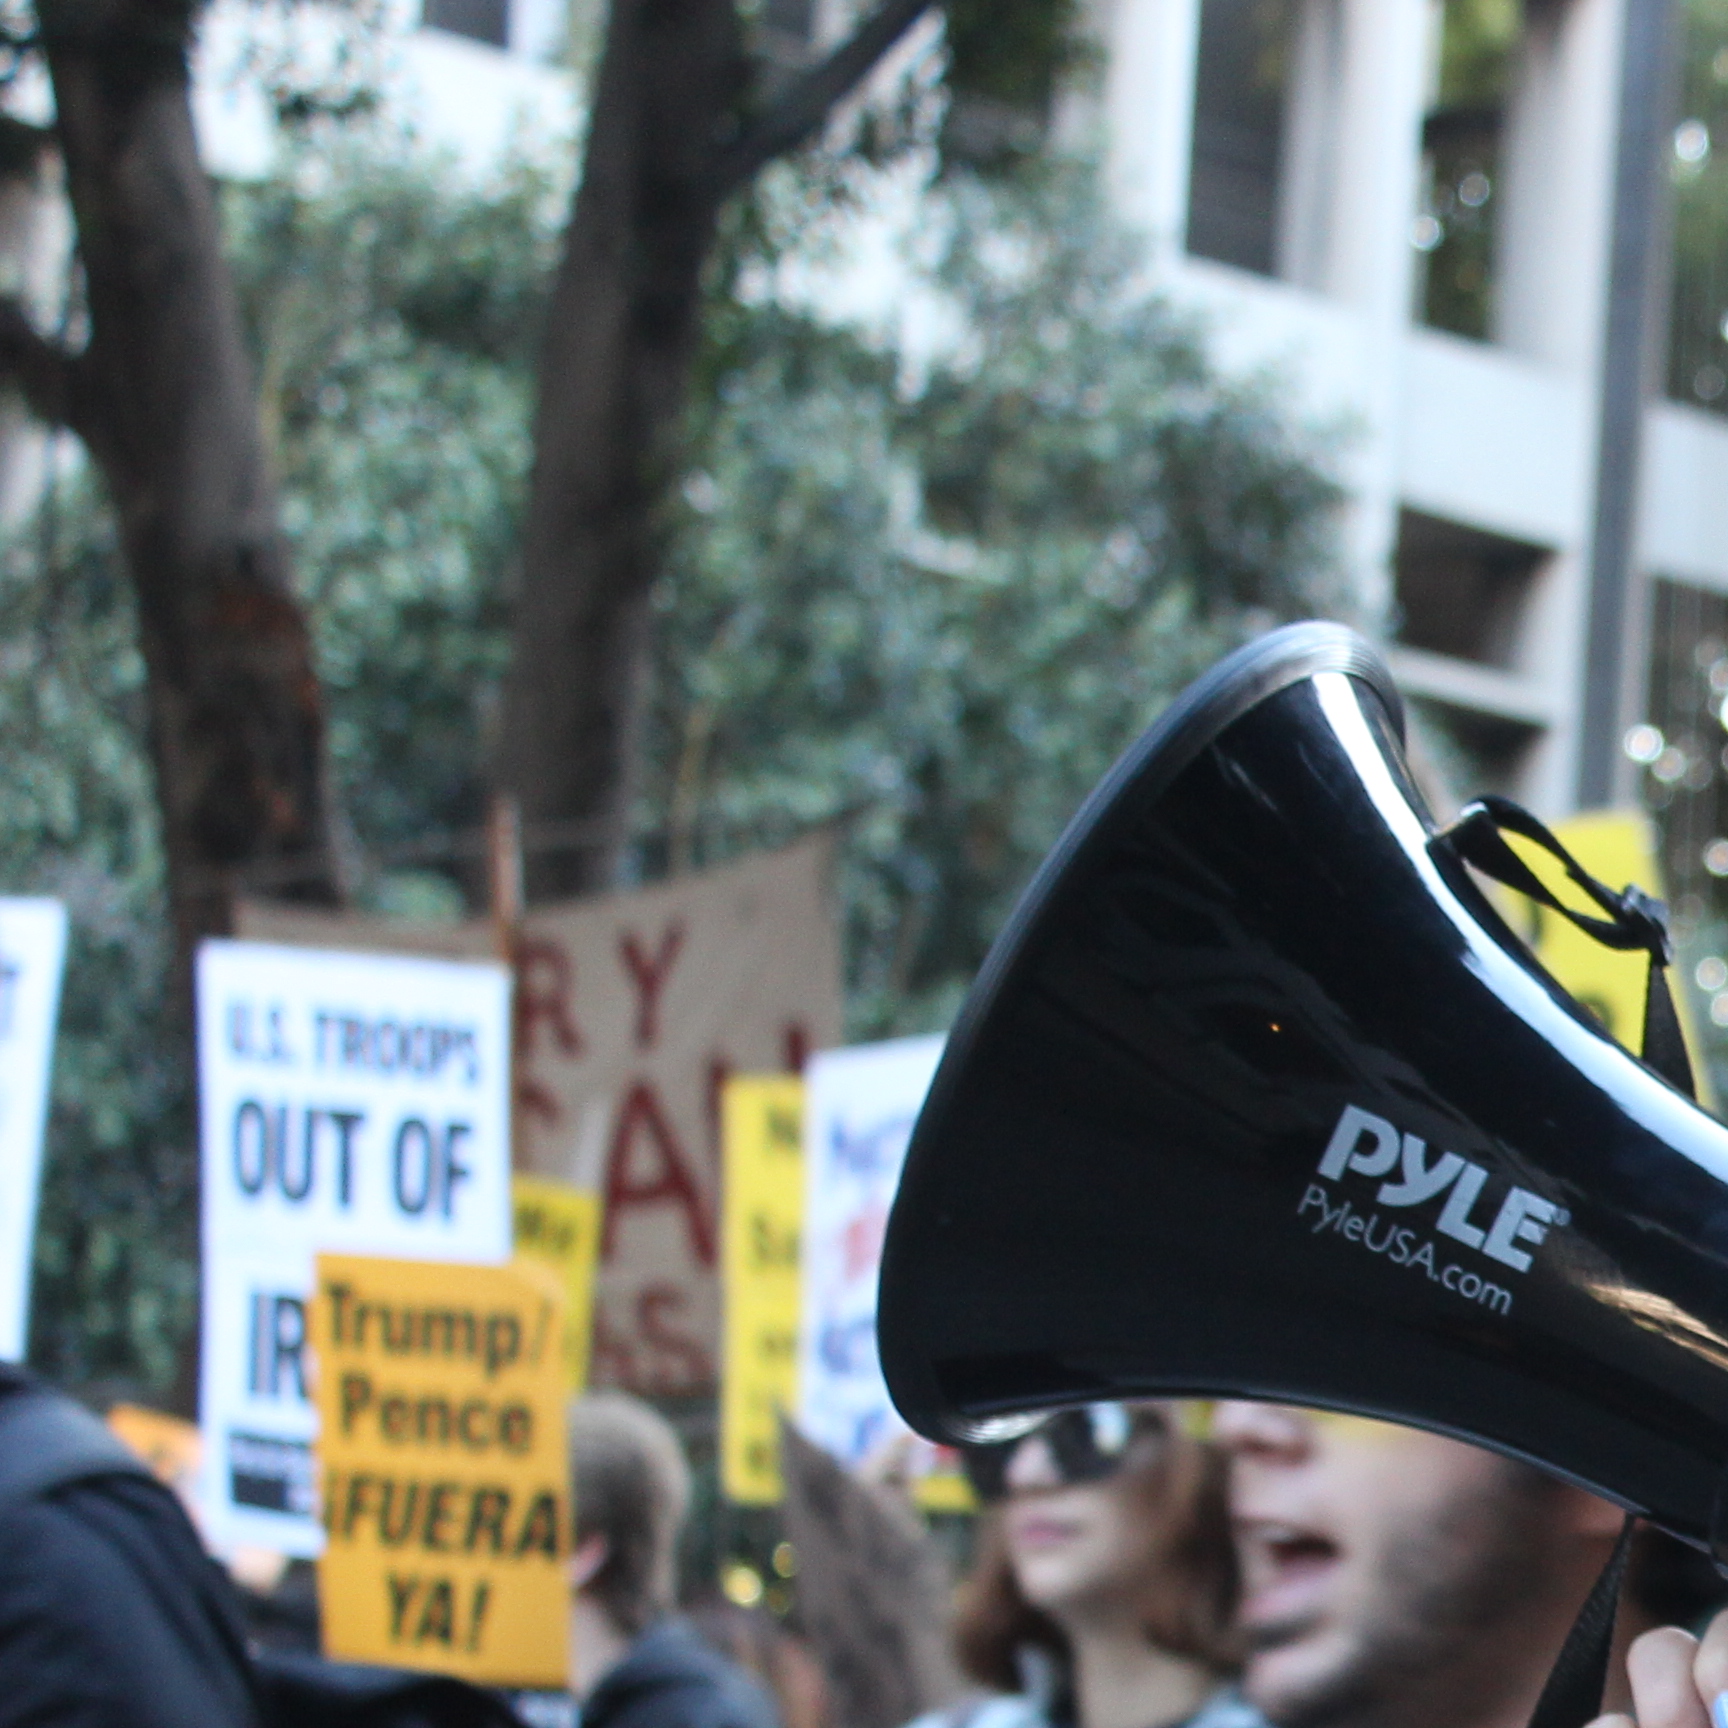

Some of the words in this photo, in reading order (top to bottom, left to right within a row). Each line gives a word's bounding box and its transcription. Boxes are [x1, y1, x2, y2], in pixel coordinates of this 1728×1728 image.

[228, 998, 294, 1070] U.S.
[316, 1010, 482, 1090] TROOPS
[232, 1099, 363, 1208] OUT
[393, 1112, 473, 1222] OF
[1316, 1103, 1559, 1274] PYLE
[1297, 1182, 1514, 1317] PyleUSA.com
[339, 1371, 535, 1456] Pence
[386, 1572, 491, 1653] YA!
